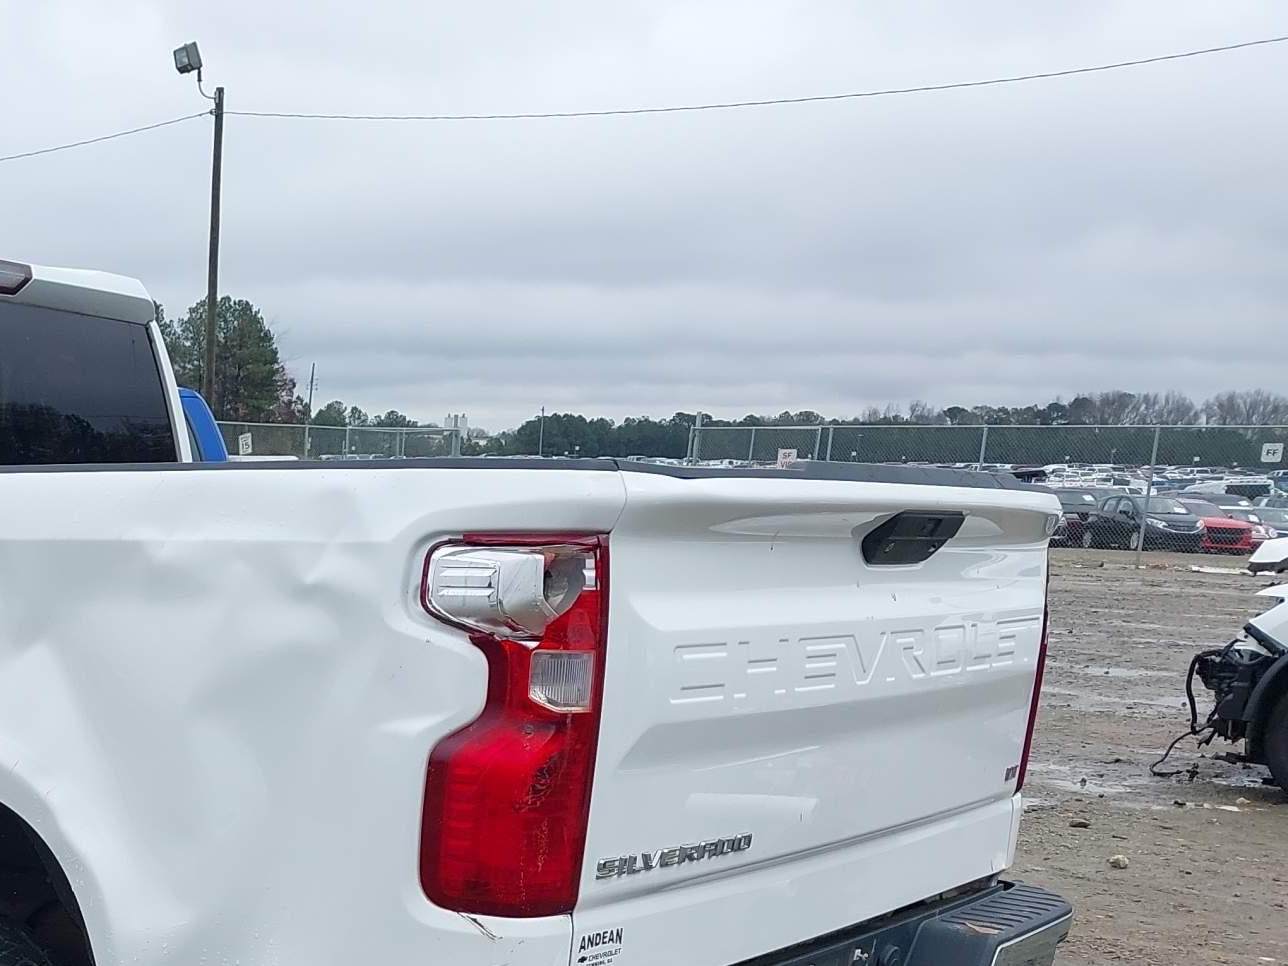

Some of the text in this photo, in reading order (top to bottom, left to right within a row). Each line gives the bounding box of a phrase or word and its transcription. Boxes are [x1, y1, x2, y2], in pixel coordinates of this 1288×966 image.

[669, 616, 1040, 704] CHEVROLET
[595, 832, 753, 880] SILVERADO
[578, 928, 623, 953] ANDEAN
[589, 948, 621, 961] CHEVROLET
